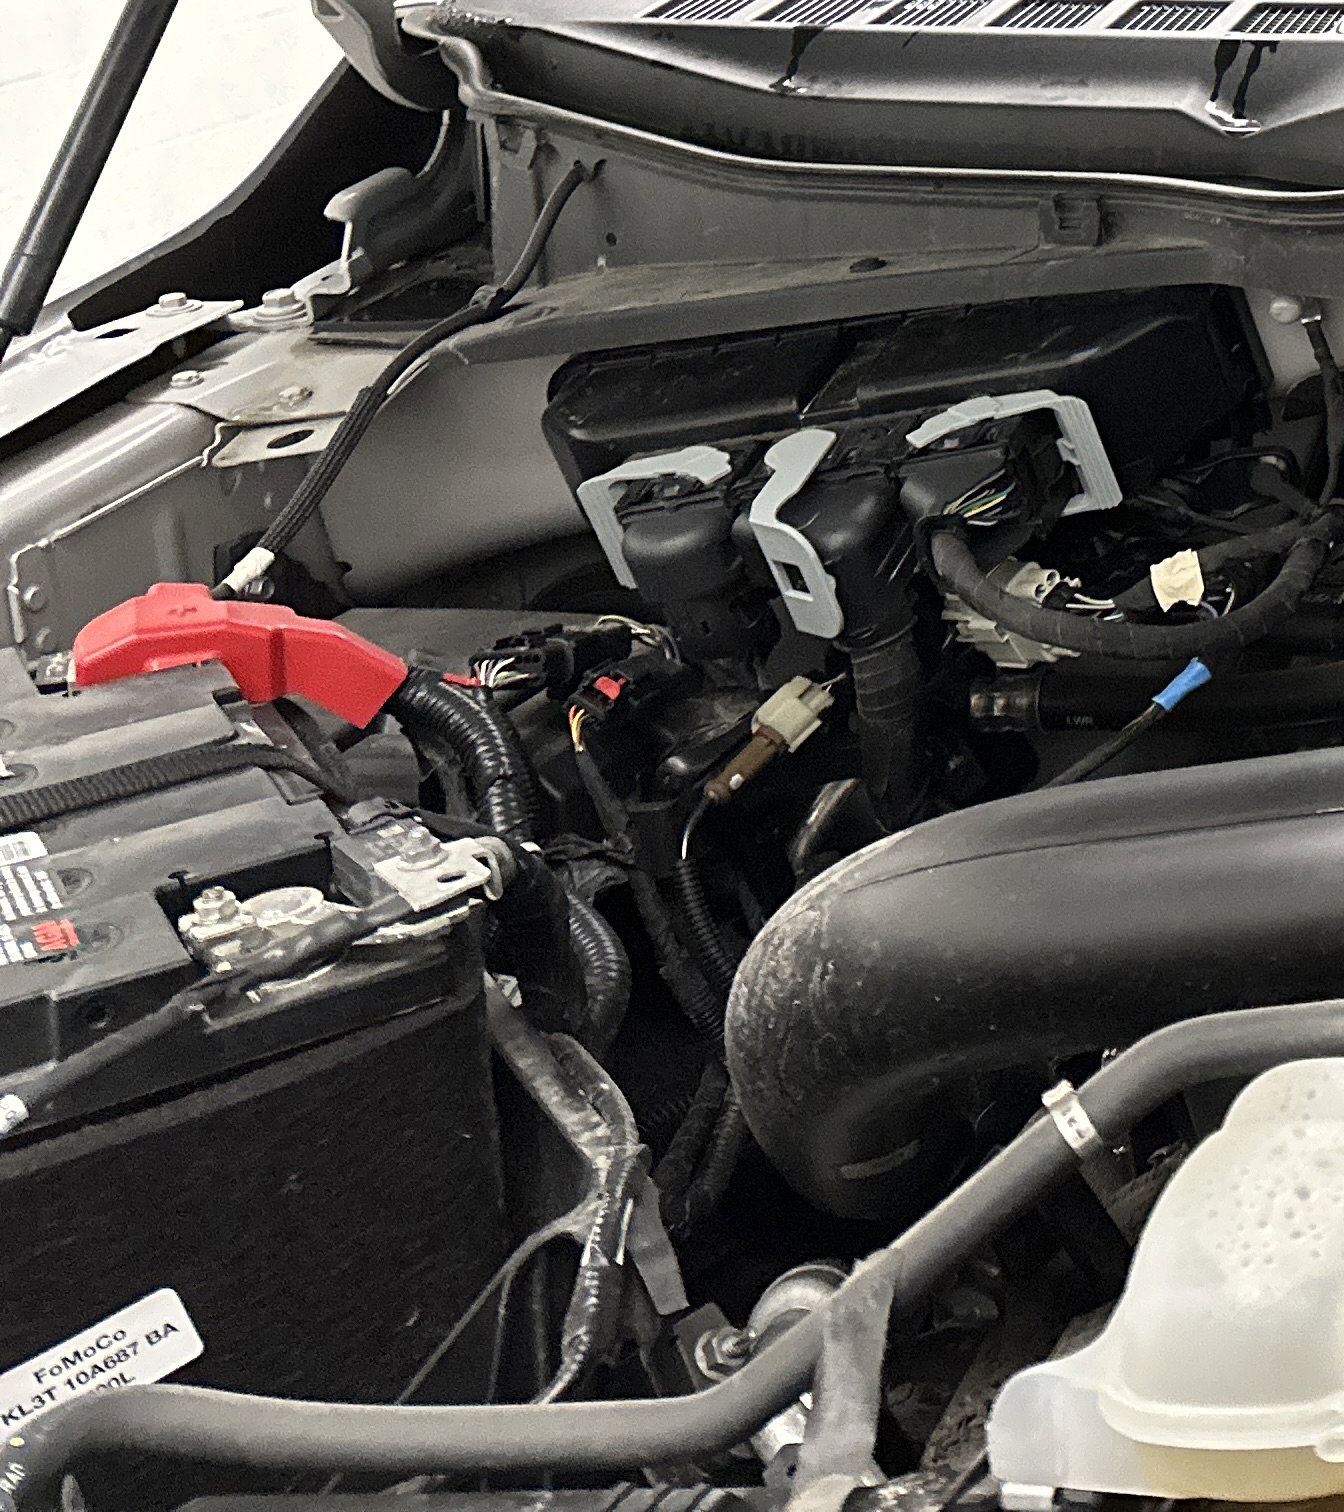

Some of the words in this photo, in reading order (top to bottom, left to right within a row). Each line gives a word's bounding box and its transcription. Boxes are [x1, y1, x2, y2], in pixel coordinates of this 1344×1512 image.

[1, 1386, 58, 1427] KL3T
[66, 1341, 140, 1391] 10A687
[145, 1322, 180, 1346] BA
[33, 1329, 127, 1384] FoMoCo
